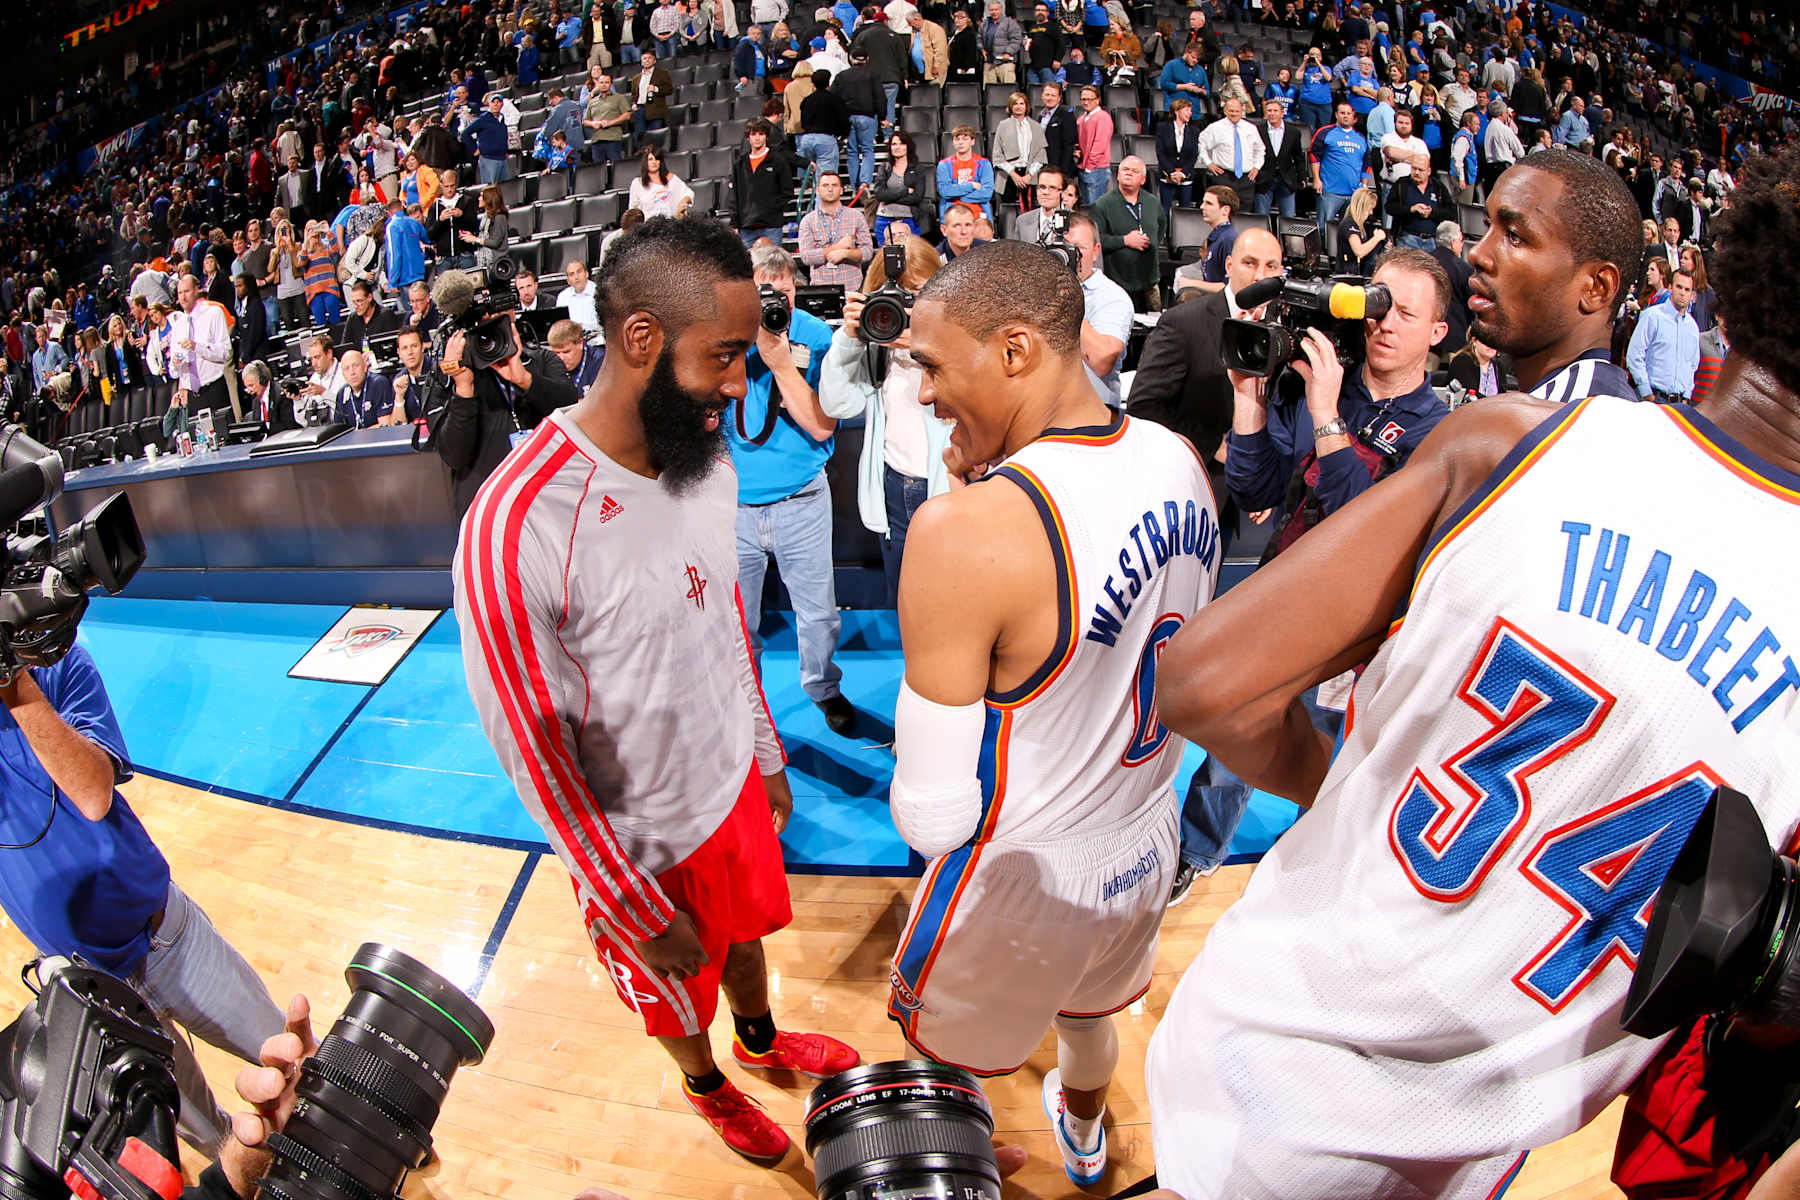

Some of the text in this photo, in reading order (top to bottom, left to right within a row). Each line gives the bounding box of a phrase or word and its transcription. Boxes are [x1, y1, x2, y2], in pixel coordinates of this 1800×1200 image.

[1752, 93, 1785, 112] OKC
[1382, 426, 1402, 443] 6
[600, 505, 624, 524] adidas
[1086, 500, 1219, 648] WESTBROOK
[1557, 520, 1800, 735] THABEET
[1388, 615, 1734, 1015] 34
[379, 1032, 394, 1045] FOR
[397, 1043, 420, 1062] SUPER
[830, 1101, 852, 1114] ZOOM
[856, 1093, 877, 1104] LENS
[881, 1090, 892, 1098] EF
[942, 1089, 953, 1097] 1:4
